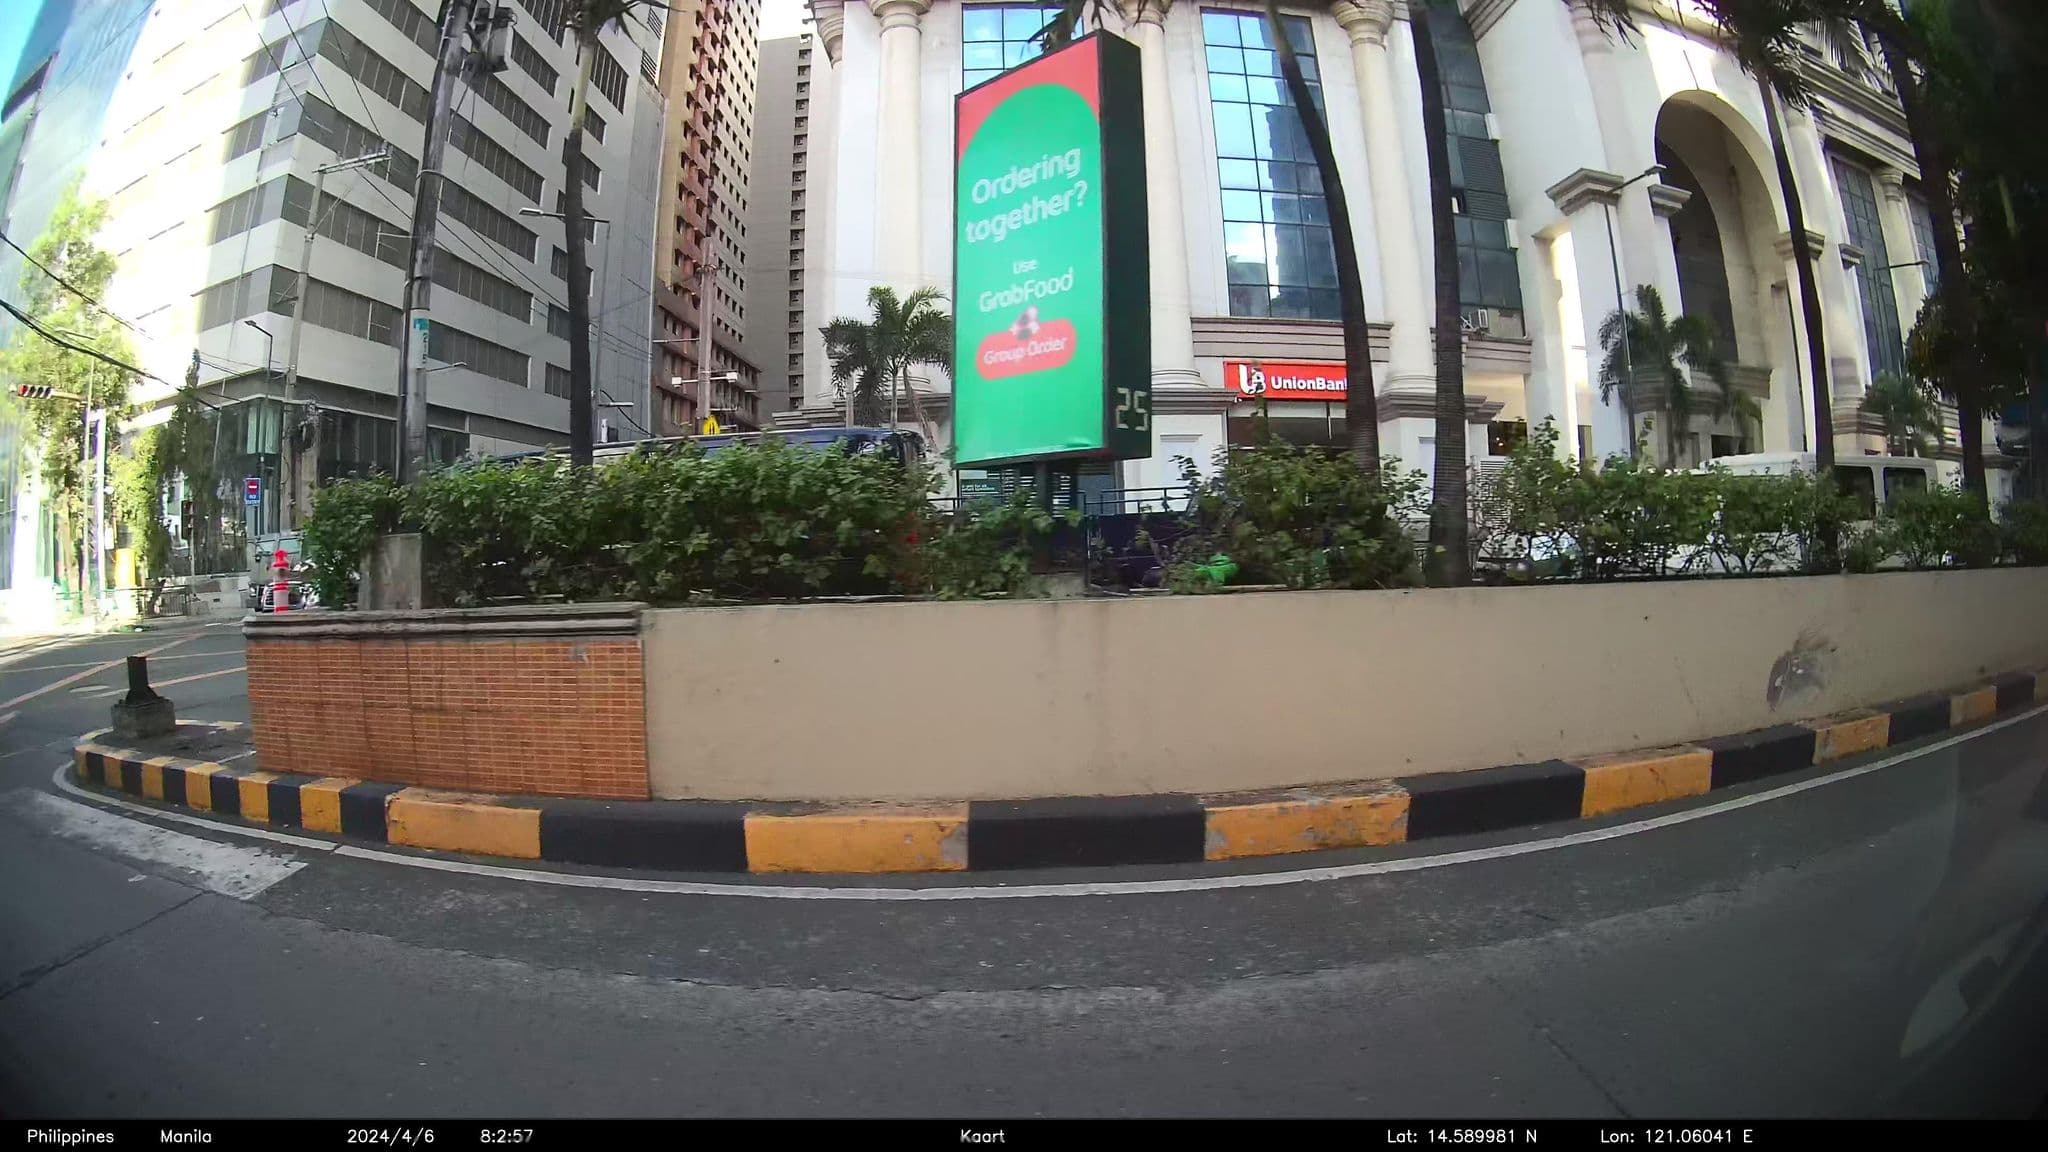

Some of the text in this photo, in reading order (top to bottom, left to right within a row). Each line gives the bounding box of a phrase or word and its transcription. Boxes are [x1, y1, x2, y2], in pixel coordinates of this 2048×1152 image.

[971, 147, 1082, 205] Ordering
[966, 180, 1089, 243] together?
[979, 265, 1074, 313] GrabFood
[983, 337, 1068, 365] Group Order
[1115, 386, 1148, 431] 25
